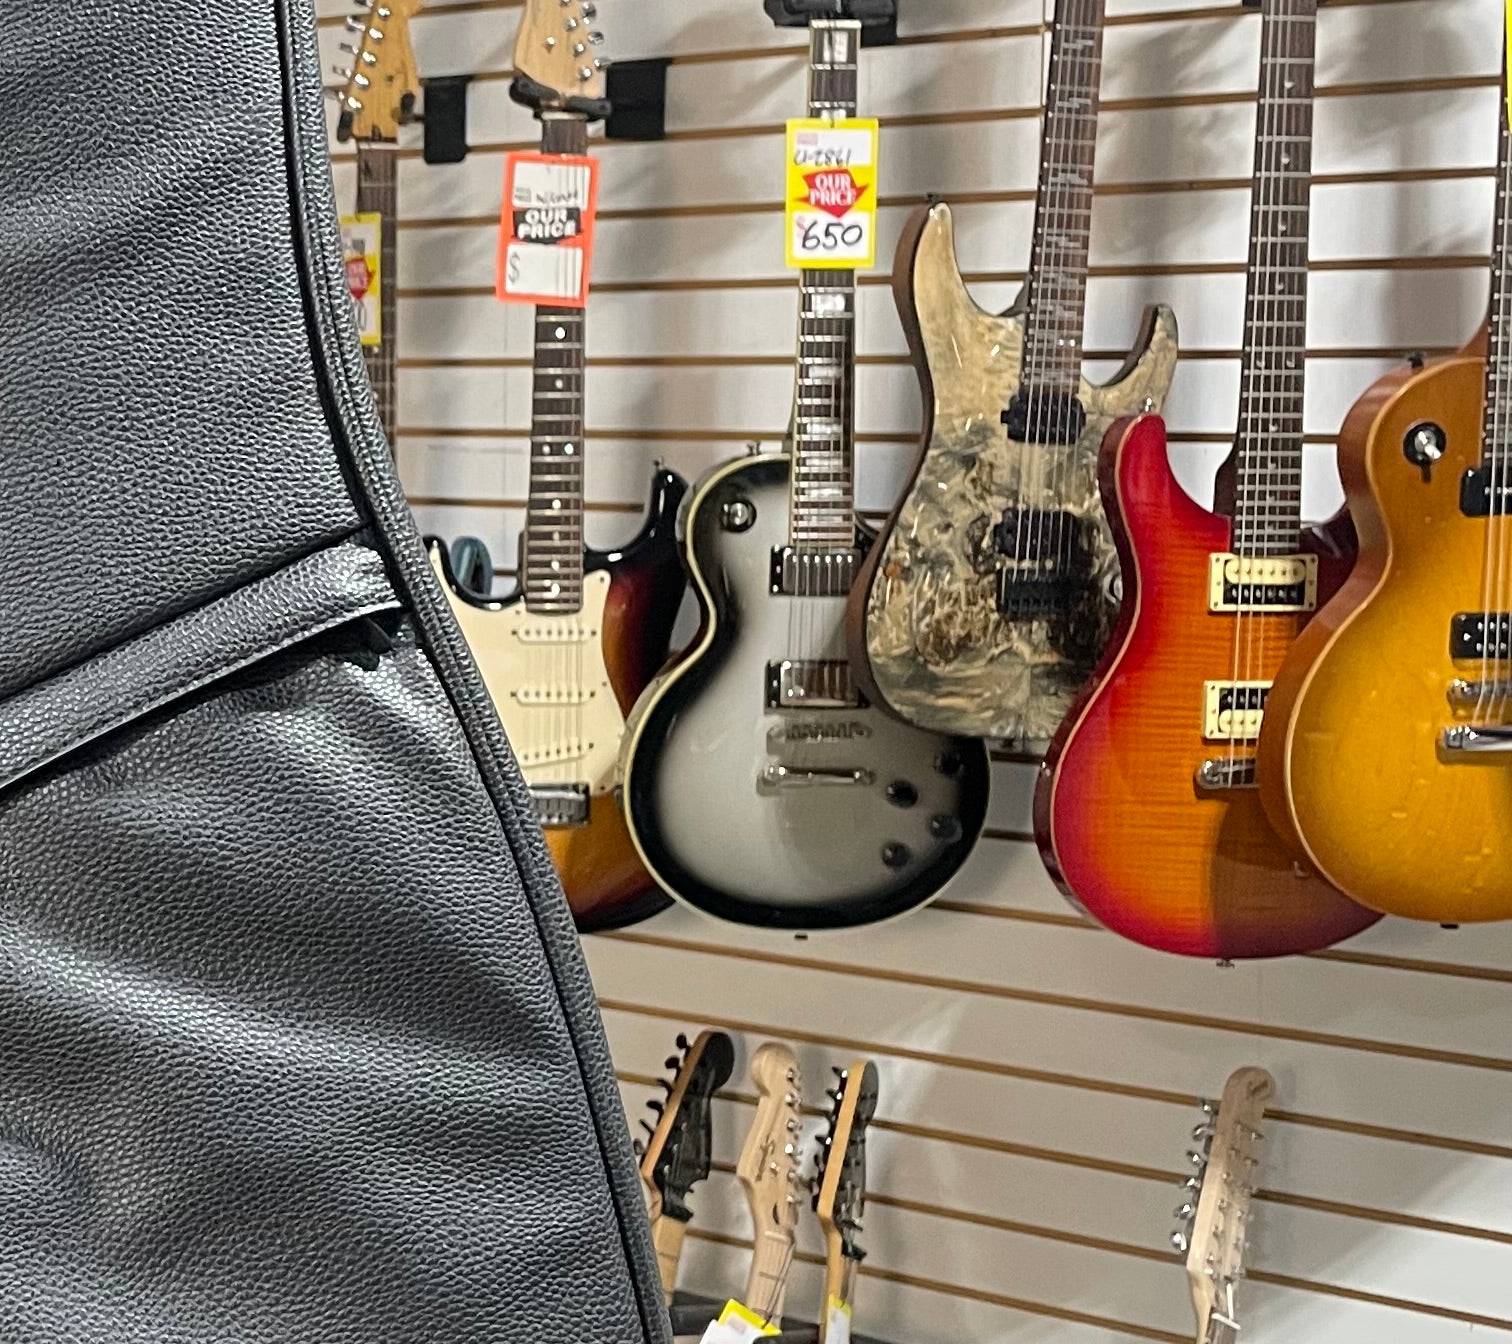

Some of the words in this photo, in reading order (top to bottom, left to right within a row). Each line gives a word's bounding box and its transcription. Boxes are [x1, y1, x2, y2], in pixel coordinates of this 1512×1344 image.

[814, 172, 851, 190] OUR
[809, 187, 857, 207] PRICE
[525, 208, 568, 225] OUR
[517, 219, 577, 240] PRICE
